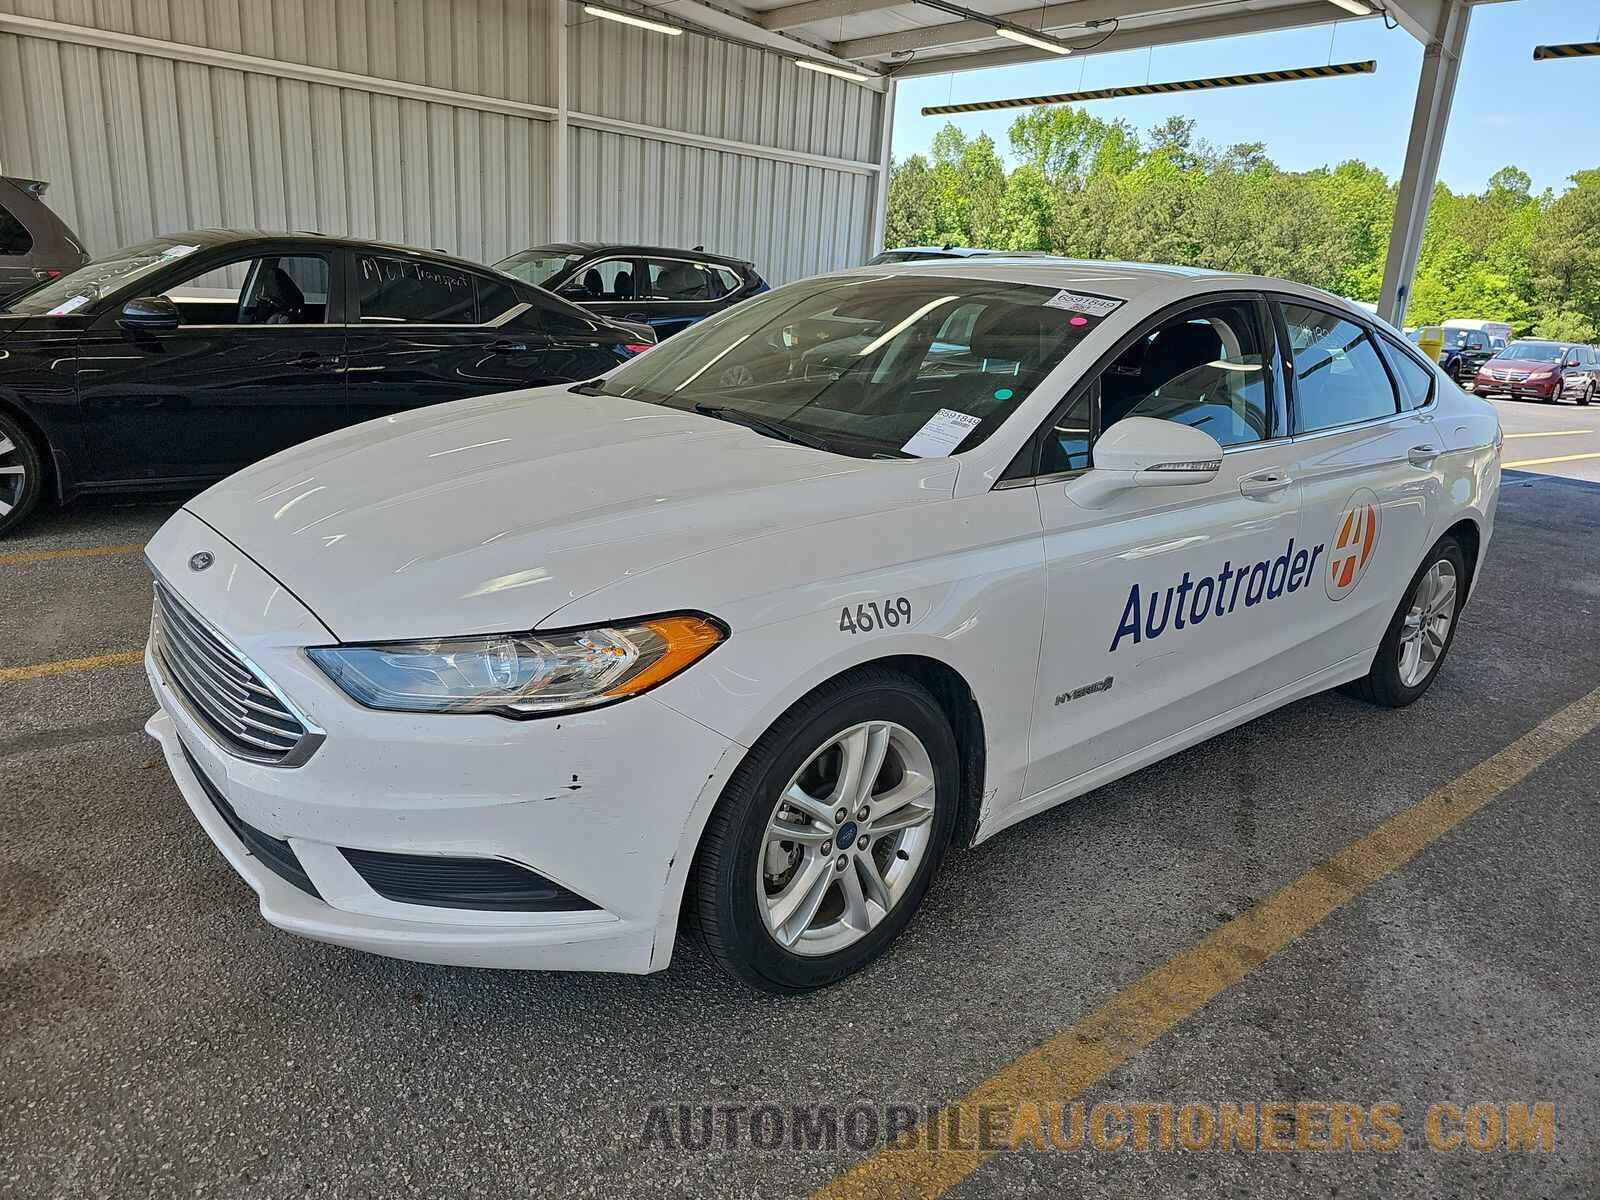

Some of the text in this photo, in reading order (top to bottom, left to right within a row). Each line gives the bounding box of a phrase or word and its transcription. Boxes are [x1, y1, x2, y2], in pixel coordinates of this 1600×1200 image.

[937, 409, 981, 426] 6591849
[1108, 538, 1325, 653] Autotrader
[839, 597, 912, 635] 46169
